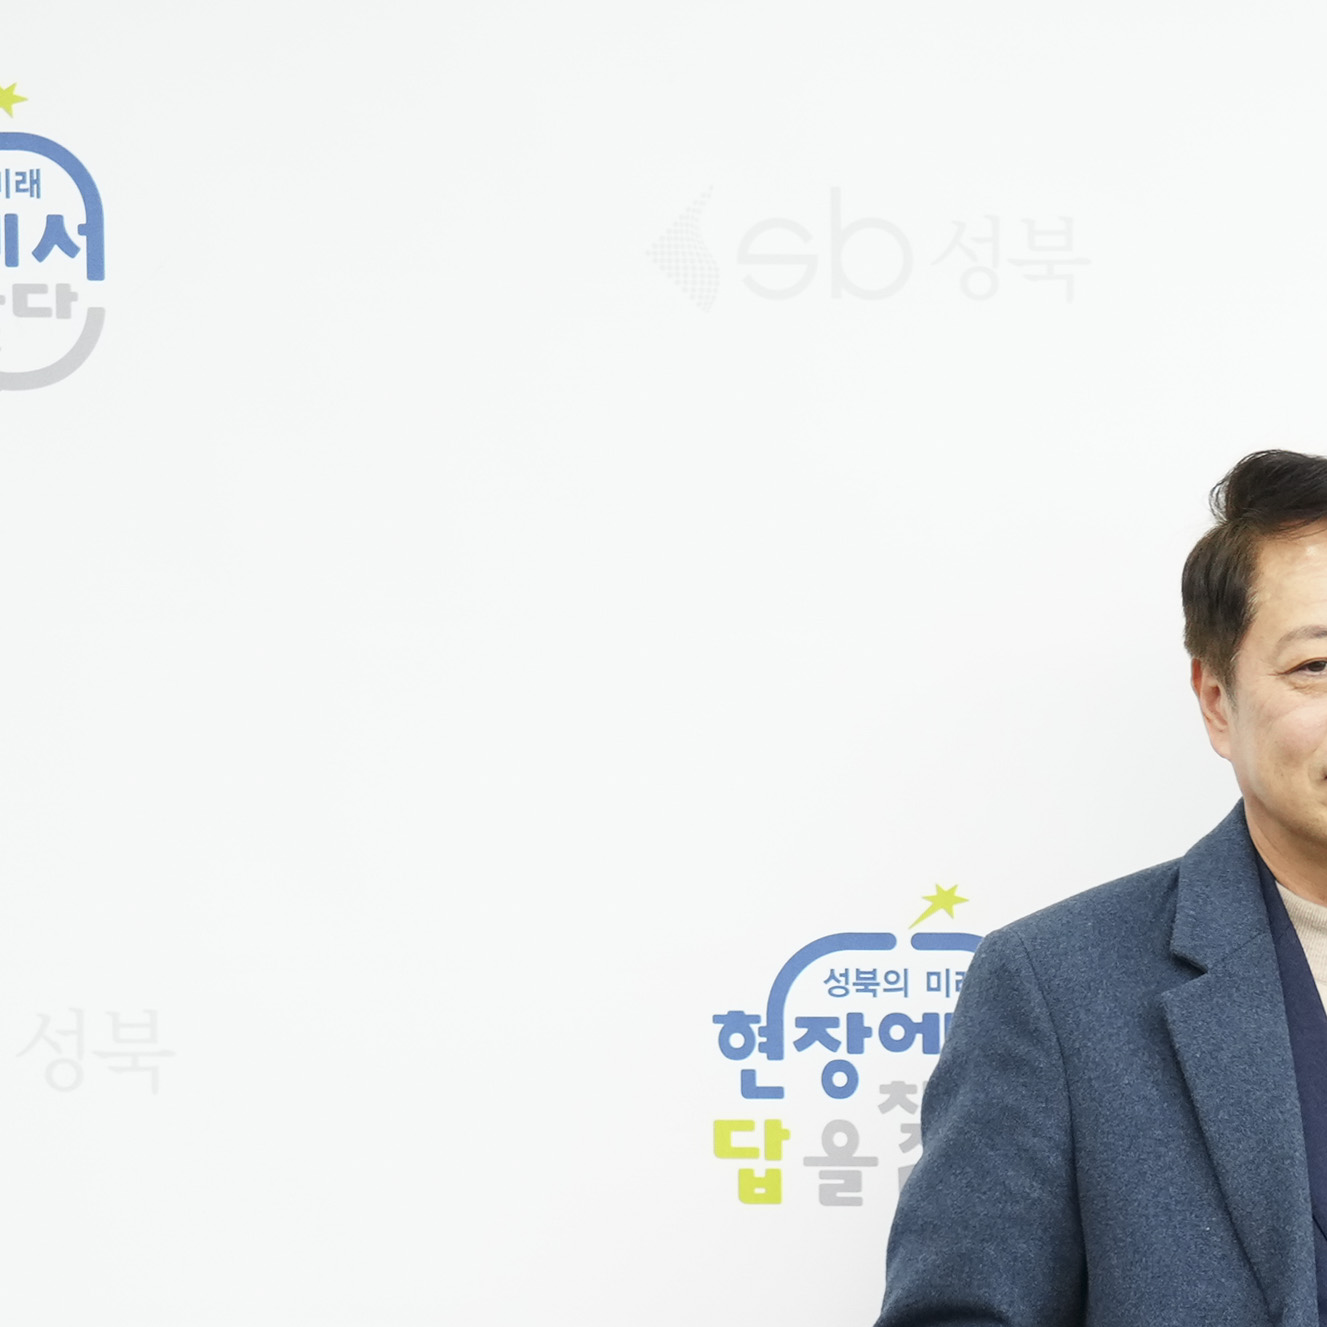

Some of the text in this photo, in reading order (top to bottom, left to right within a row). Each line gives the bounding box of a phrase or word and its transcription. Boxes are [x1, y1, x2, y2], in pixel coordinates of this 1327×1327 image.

[737, 186, 1092, 304] sb 성북
[823, 968, 909, 998] 성북의
[15, 1007, 177, 1096] 성북
[712, 1010, 954, 1100] 현장에
